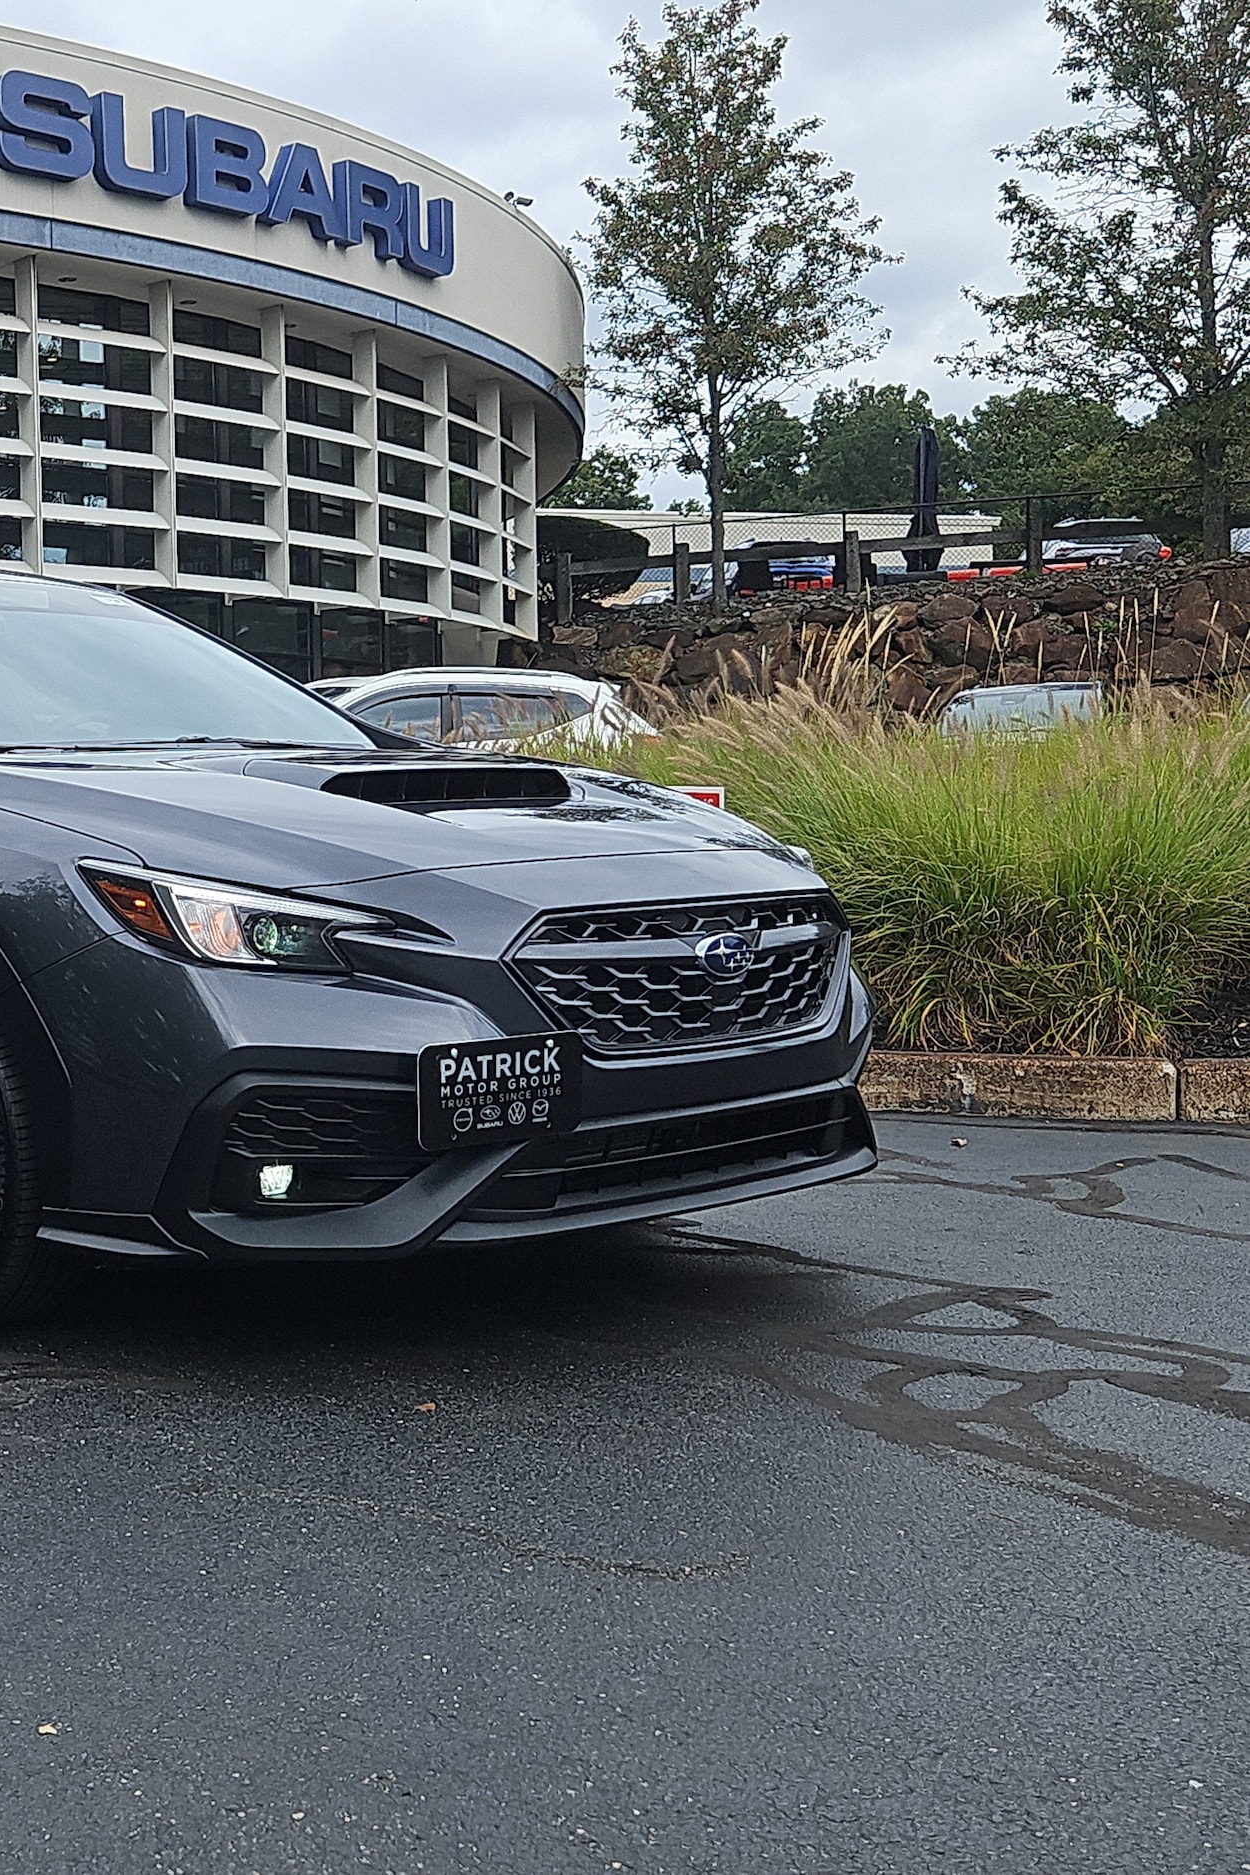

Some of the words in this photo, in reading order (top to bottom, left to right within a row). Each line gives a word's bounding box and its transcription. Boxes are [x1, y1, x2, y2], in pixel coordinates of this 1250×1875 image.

[440, 1047, 561, 1083] PATRICK
[440, 1081, 498, 1098] MOTOR
[508, 1073, 561, 1090] GROUP
[441, 1095, 493, 1109] TRUSTED
[499, 1090, 531, 1102] SINCE
[537, 1086, 561, 1098] 1936
